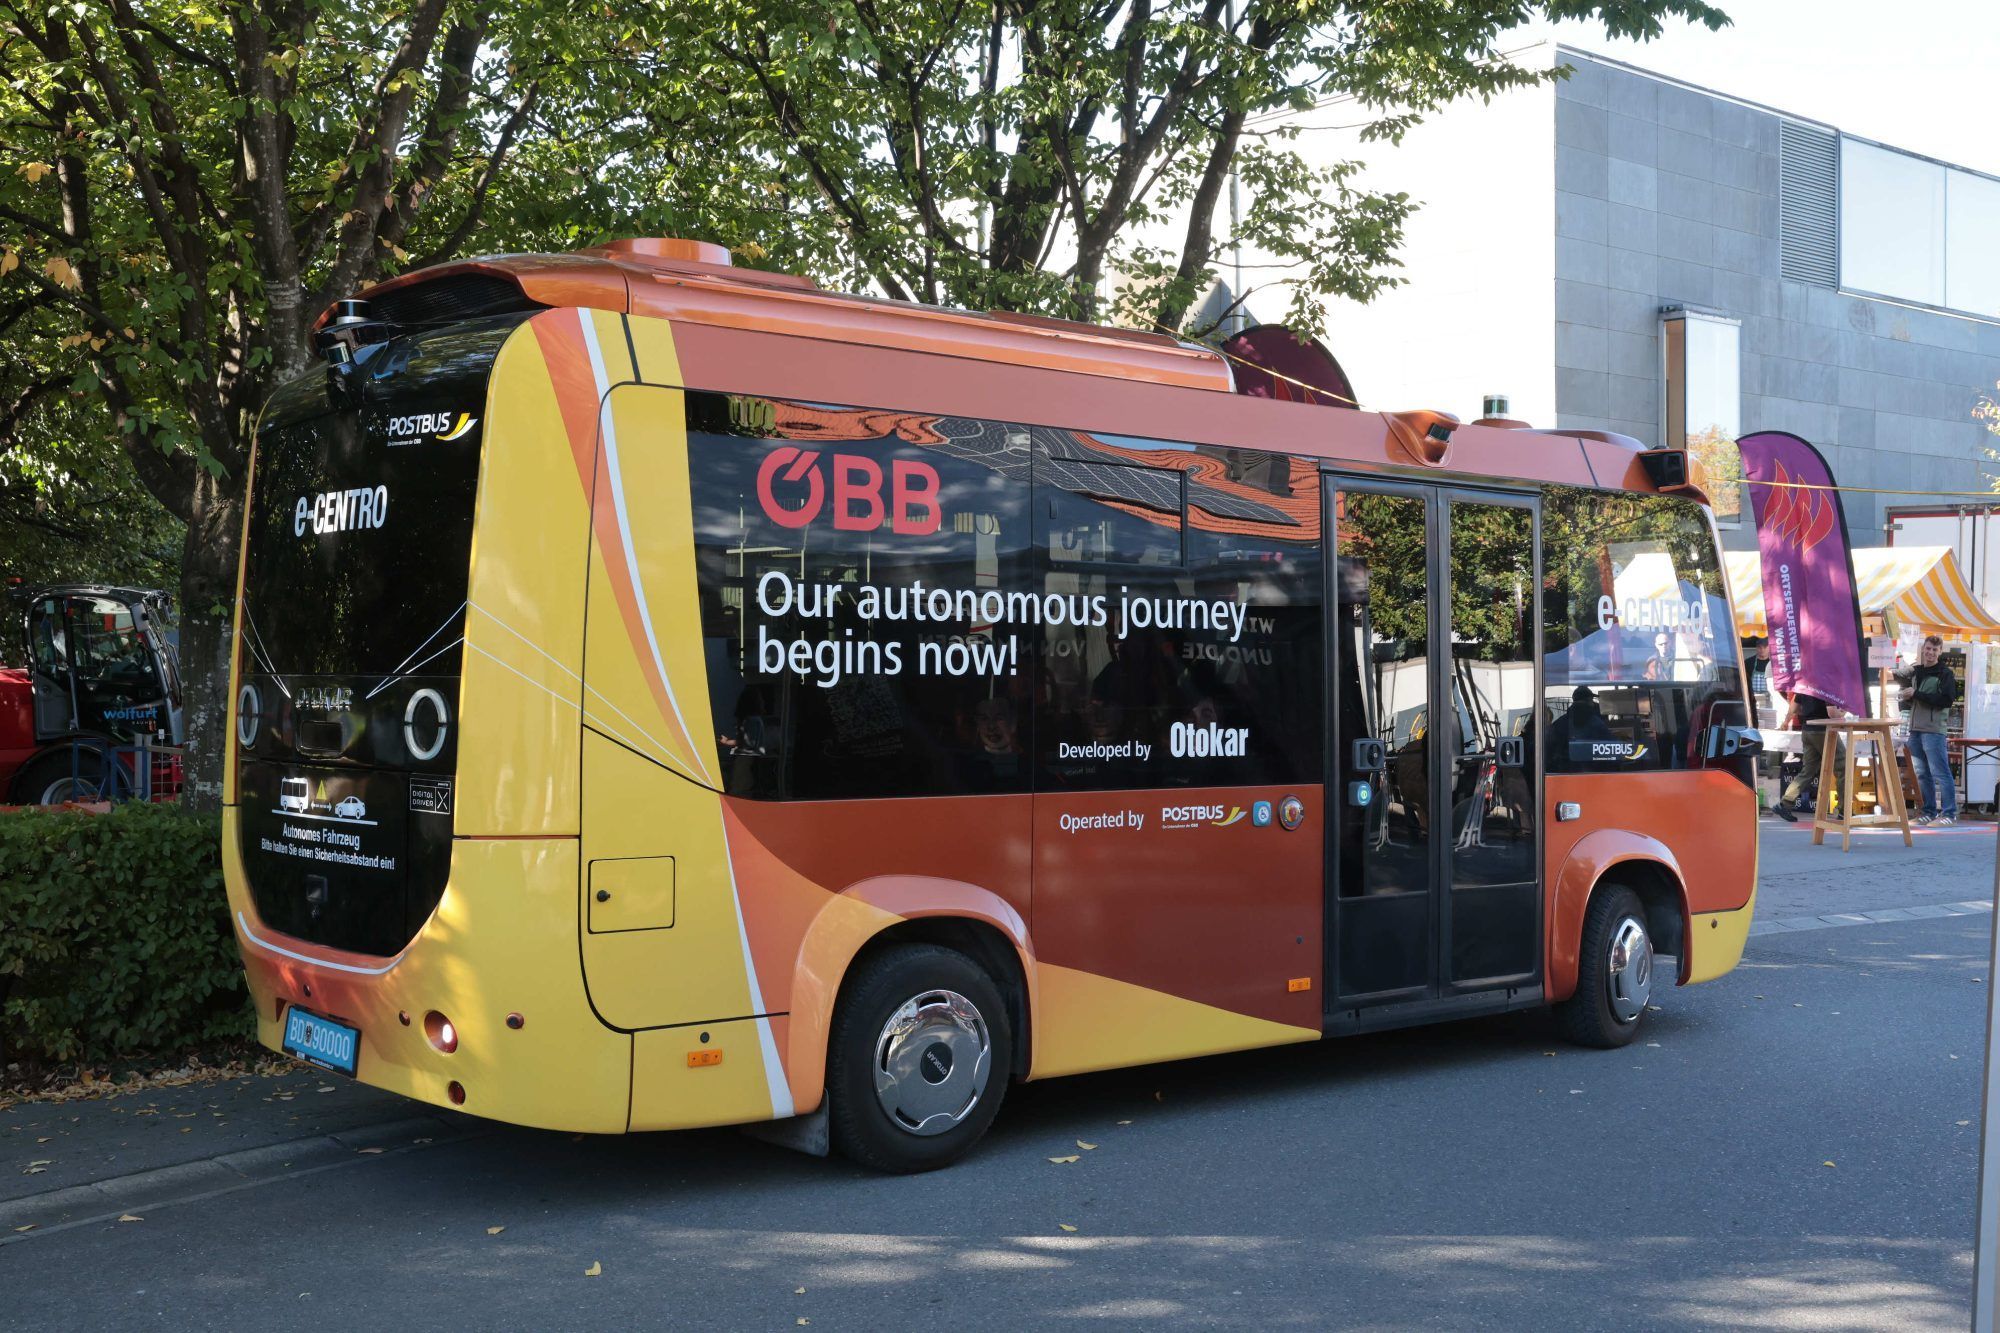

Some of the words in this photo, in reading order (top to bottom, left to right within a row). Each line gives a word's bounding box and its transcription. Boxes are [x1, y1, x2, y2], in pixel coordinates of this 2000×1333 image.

[388, 412, 451, 436] POSTBUS
[294, 484, 388, 537] e-CENTRO
[757, 447, 941, 536] ÖBB
[757, 571, 842, 618] Our
[857, 580, 1107, 627] autonomous
[1118, 586, 1247, 642] journey
[1597, 594, 1703, 635] e-CENTRO
[1779, 564, 1801, 672] ORTSFEUERWEHR
[758, 625, 902, 688] begins
[919, 635, 1017, 676] now!
[1774, 627, 1788, 674] Wolfurt
[103, 705, 158, 720] wolfurt
[1059, 741, 1131, 761] Developed
[1135, 741, 1151, 761] by
[1170, 722, 1249, 757] Otokar
[1592, 744, 1633, 755] POSTBUS
[282, 822, 320, 842] Autonomes
[322, 828, 360, 850] Fahrzeug
[1060, 810, 1124, 833] Operated
[1128, 810, 1144, 830] by
[1162, 805, 1224, 821] POSTBUS
[261, 838, 272, 851] Bitte
[272, 840, 288, 855] halten
[288, 843, 297, 856] Sie
[298, 845, 314, 859] einen
[314, 848, 379, 868] Sicherheitsabstand
[380, 857, 395, 870] ein!
[290, 1016, 305, 1043] BD
[312, 1025, 350, 1061] 90000
[926, 1051, 948, 1075] OTOKAR
